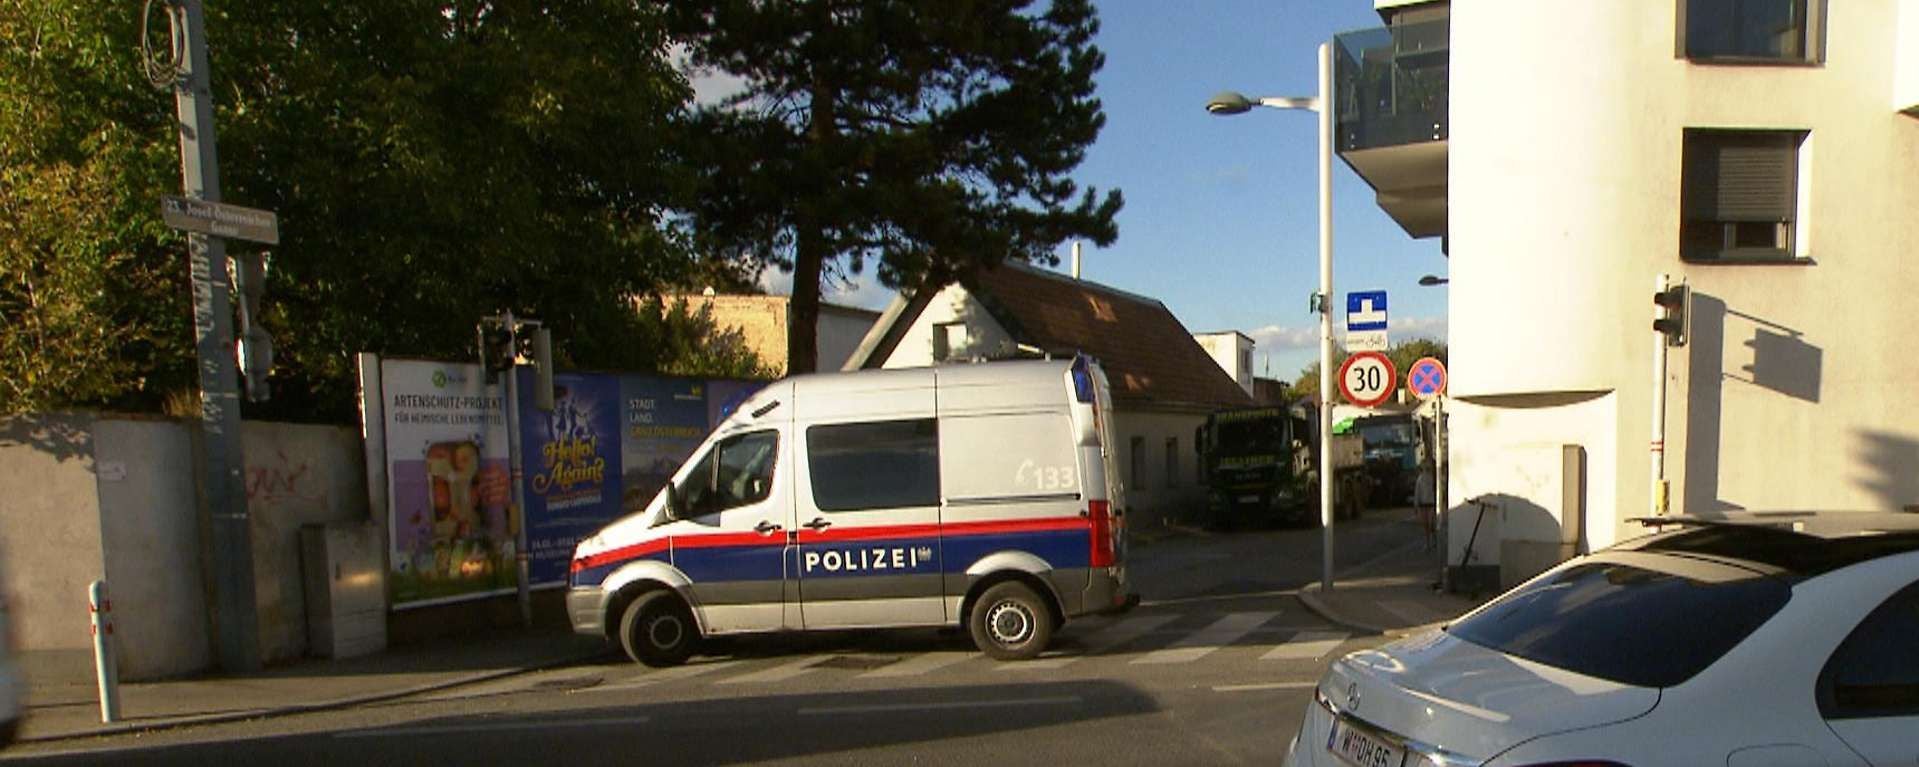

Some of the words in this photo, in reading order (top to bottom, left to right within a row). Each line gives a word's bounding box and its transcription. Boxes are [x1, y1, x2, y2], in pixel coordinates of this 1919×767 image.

[1353, 366, 1381, 392] 30
[532, 457, 605, 494] Again?
[1032, 465, 1075, 490] 133
[805, 547, 918, 572] POLIZEI
